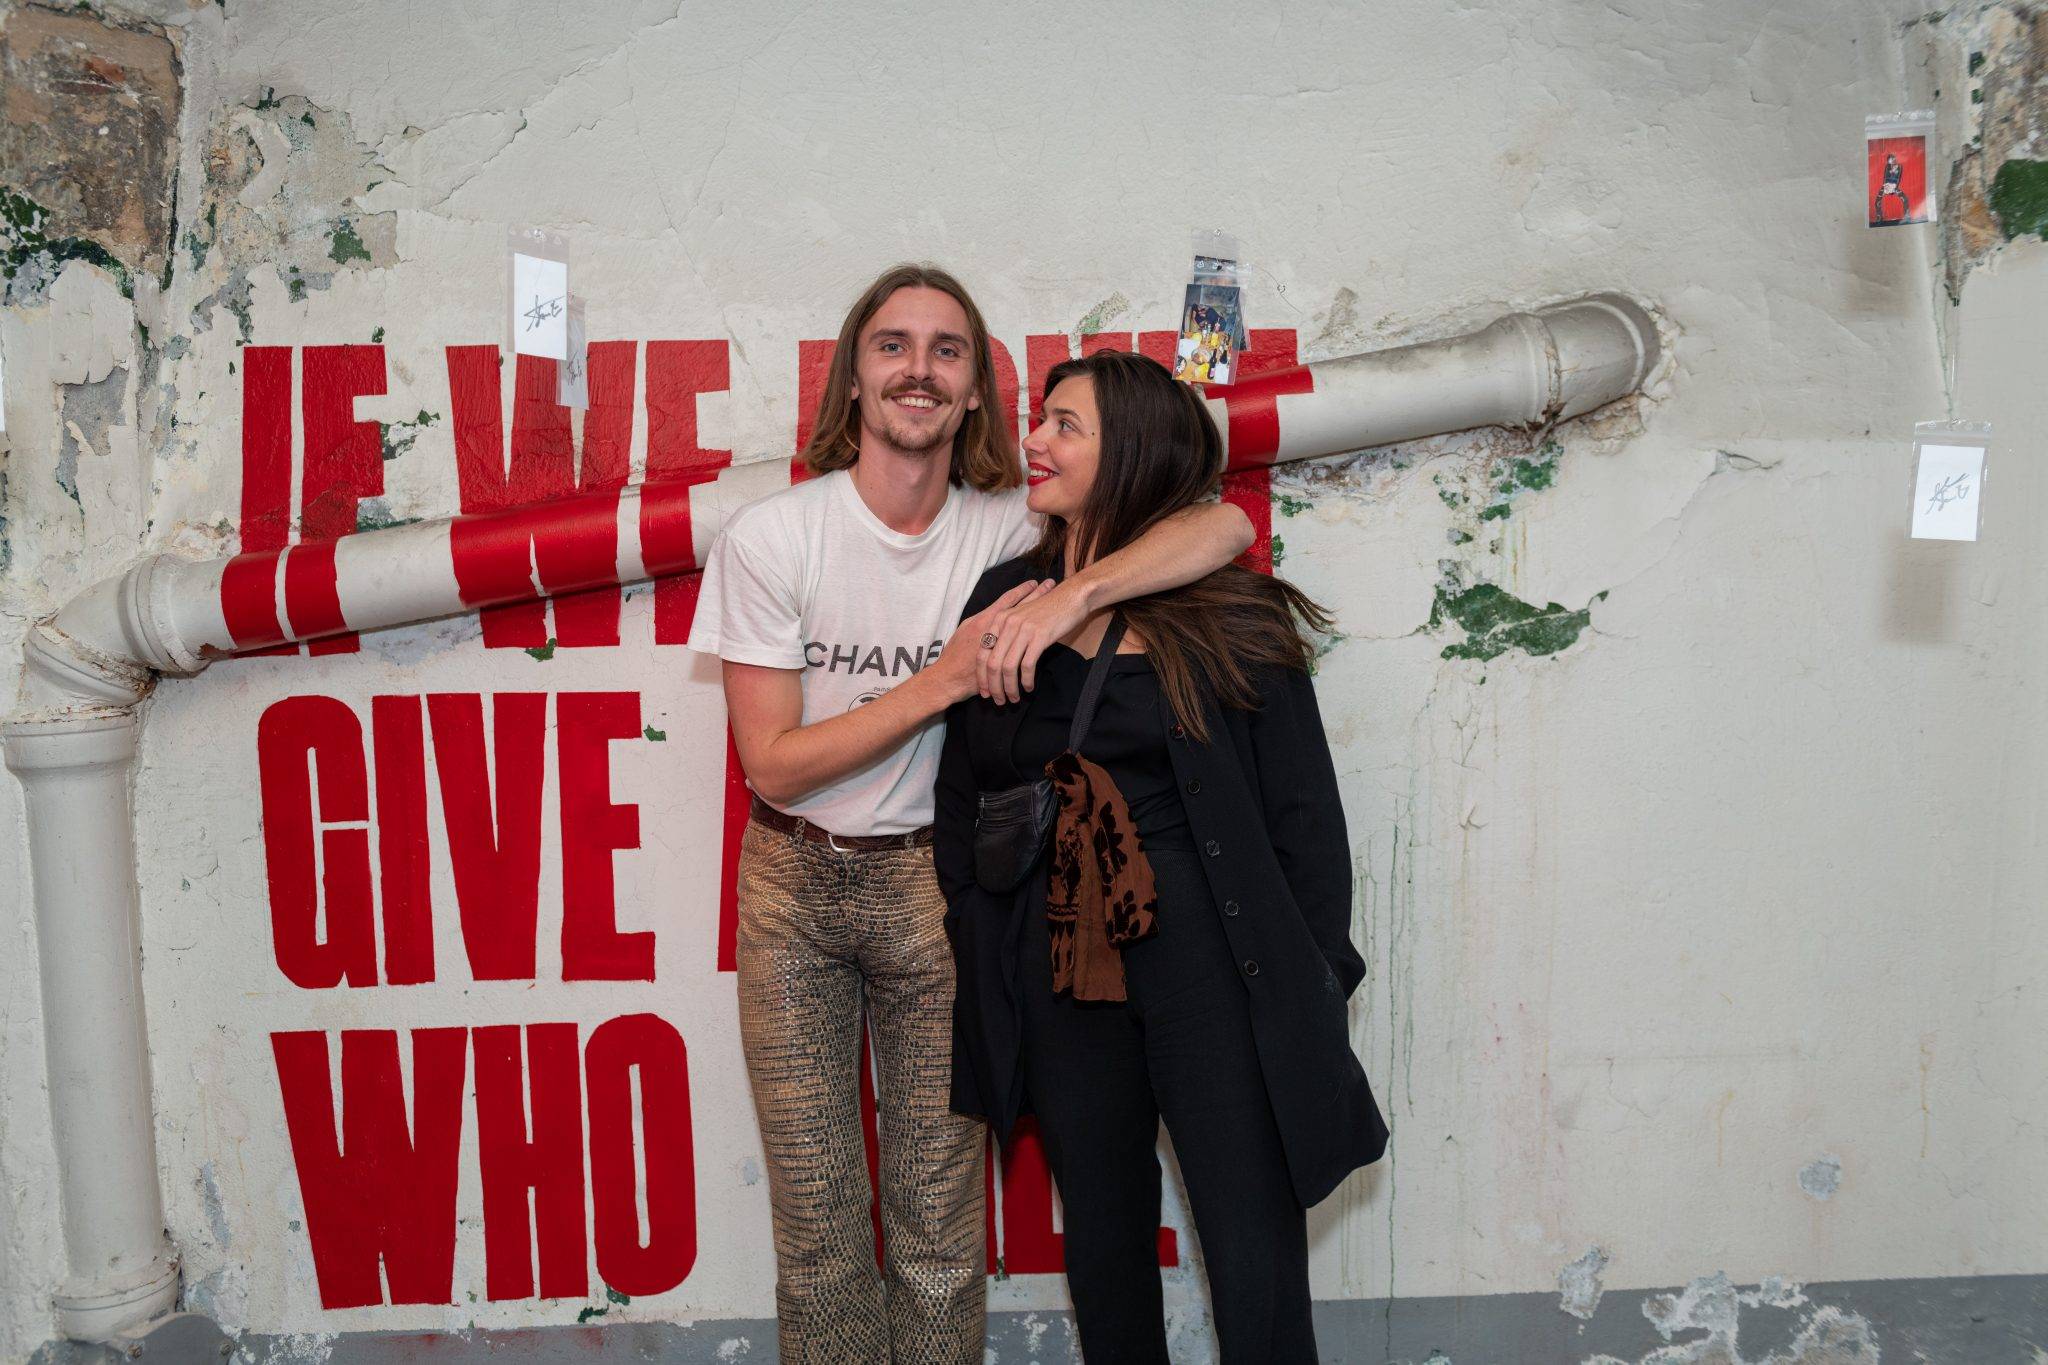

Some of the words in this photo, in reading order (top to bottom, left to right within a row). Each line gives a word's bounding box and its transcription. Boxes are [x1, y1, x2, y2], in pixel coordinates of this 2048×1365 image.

[221, 345, 388, 657] IF
[446, 339, 733, 649] WE
[804, 639, 943, 677] CHANE
[257, 690, 656, 990] GIVE
[270, 1012, 697, 1310] WHO
